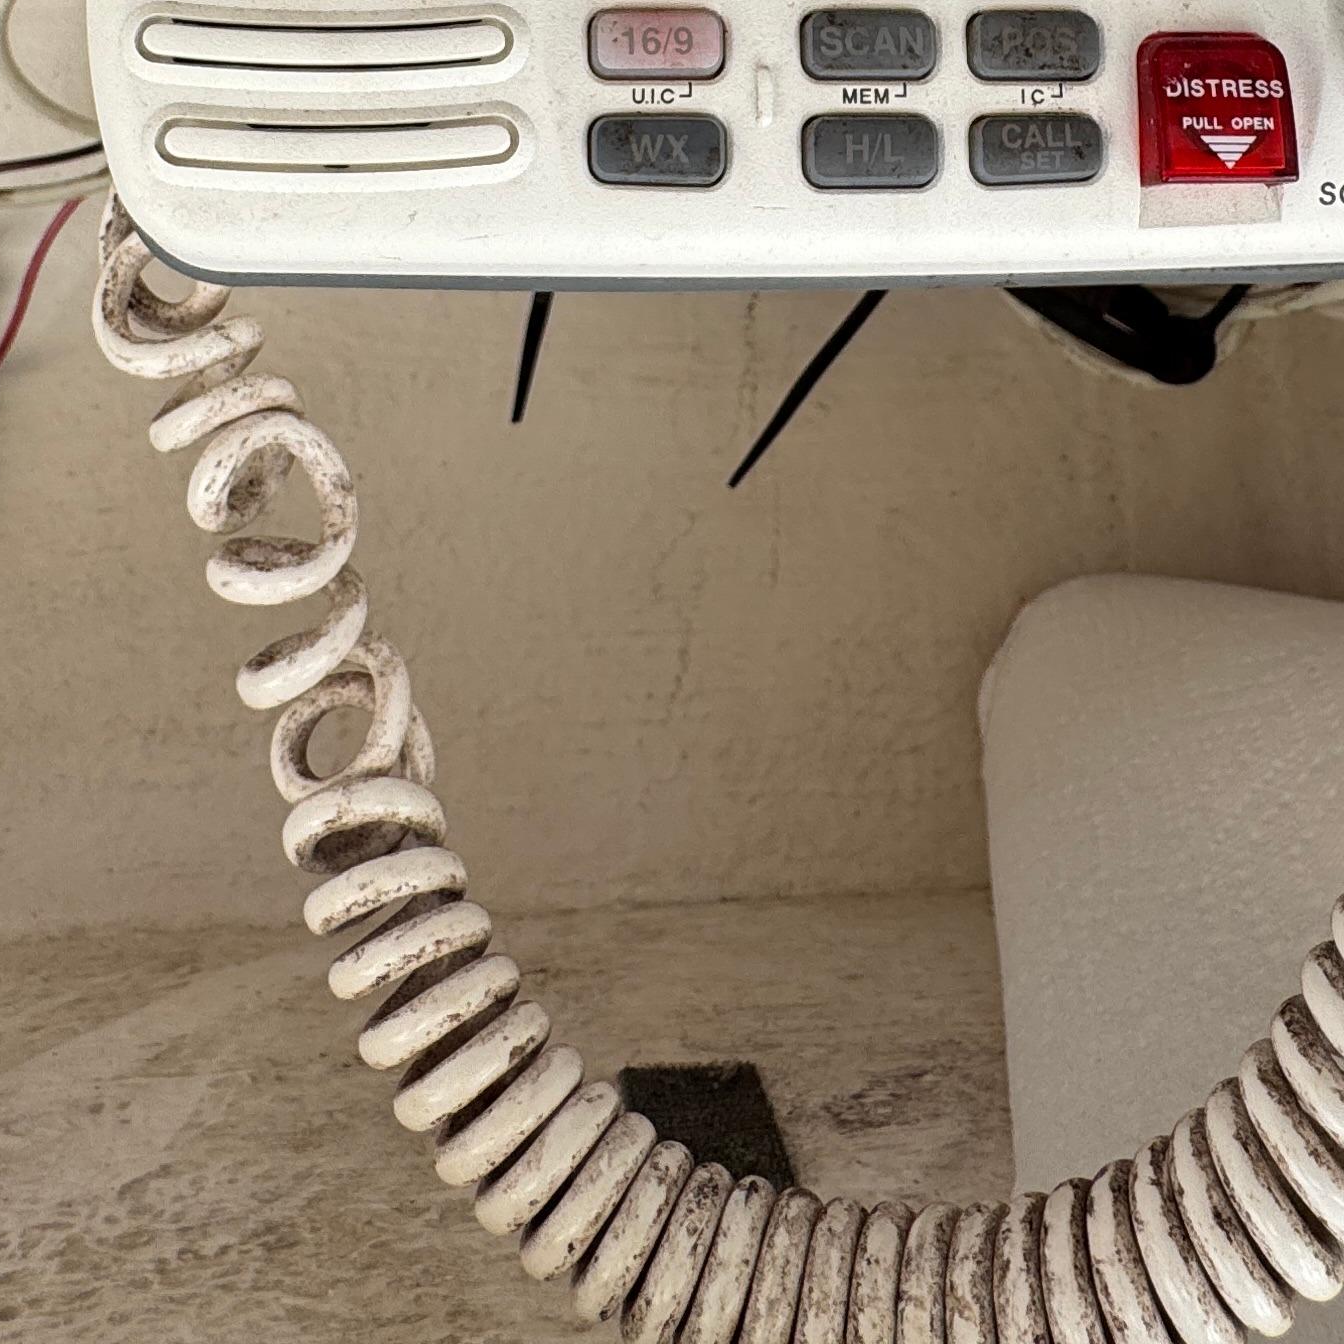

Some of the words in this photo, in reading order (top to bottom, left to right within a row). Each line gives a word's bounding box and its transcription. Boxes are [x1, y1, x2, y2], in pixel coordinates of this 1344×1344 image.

[620, 26, 695, 56] 16/9
[818, 27, 925, 58] SCAN
[631, 88, 676, 105] U.I.C
[842, 88, 891, 105] MEM
[1163, 78, 1285, 99] DISTRESS
[1000, 122, 1083, 149] CALL
[1182, 116, 1223, 131] PULL
[1231, 116, 1275, 131] OPEN
[629, 133, 691, 164] WX
[845, 133, 905, 165] H/L
[1019, 151, 1067, 171] SET
